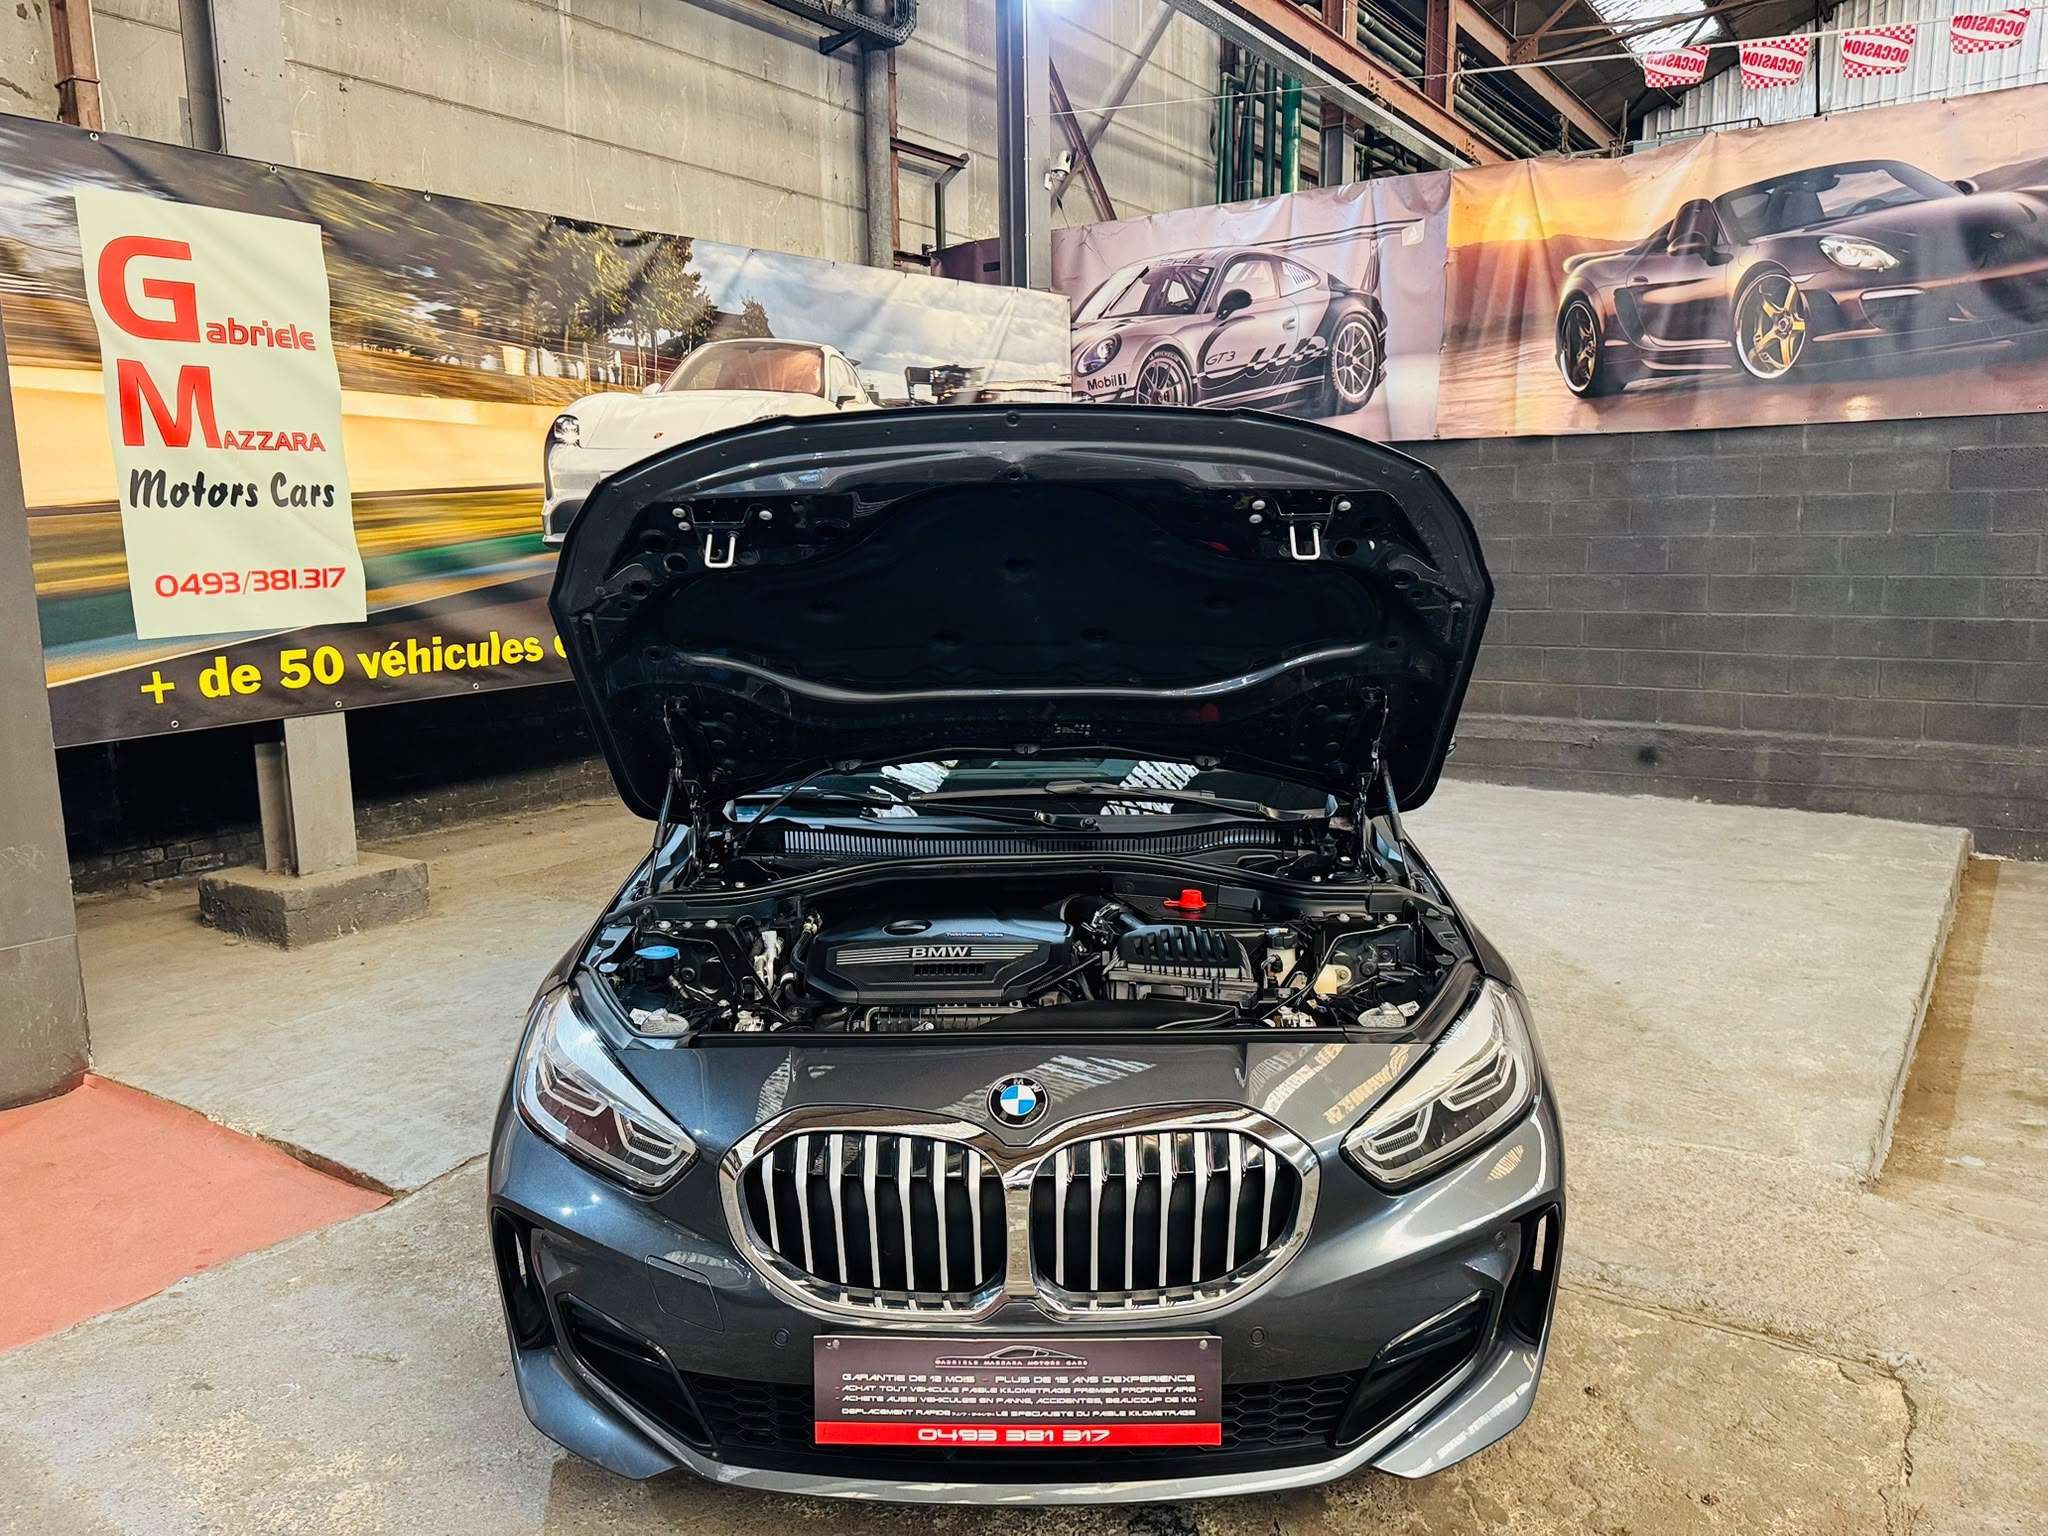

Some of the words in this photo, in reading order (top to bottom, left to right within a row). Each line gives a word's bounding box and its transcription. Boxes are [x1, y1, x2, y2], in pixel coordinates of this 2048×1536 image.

[129, 468, 258, 509] Motors
[270, 471, 335, 508] Cars
[154, 567, 346, 598] 0493/381.317
[139, 671, 176, 704] +
[198, 656, 262, 700] de
[279, 644, 345, 690] 50
[355, 631, 545, 681] véhicules
[911, 947, 969, 958] BMW
[995, 1079, 1043, 1093] BMW
[842, 1373, 906, 1382] GARANTIE
[909, 1374, 927, 1382] DE
[929, 1375, 942, 1383] 12
[945, 1375, 976, 1383] MOIS
[995, 1375, 1030, 1383] PLUS
[1033, 1375, 1052, 1383] DE
[842, 1384, 876, 1392] ACHAT
[909, 1385, 960, 1393] VEHICULE
[999, 1386, 1071, 1394] KILOMETRAGE
[919, 1396, 977, 1404] VEHICULES
[978, 1396, 994, 1404] EN
[842, 1407, 914, 1416] DEPLACEMENT
[918, 1428, 998, 1441] 0493
[1005, 1429, 1054, 1441] 381
[1062, 1429, 1111, 1441] 317
